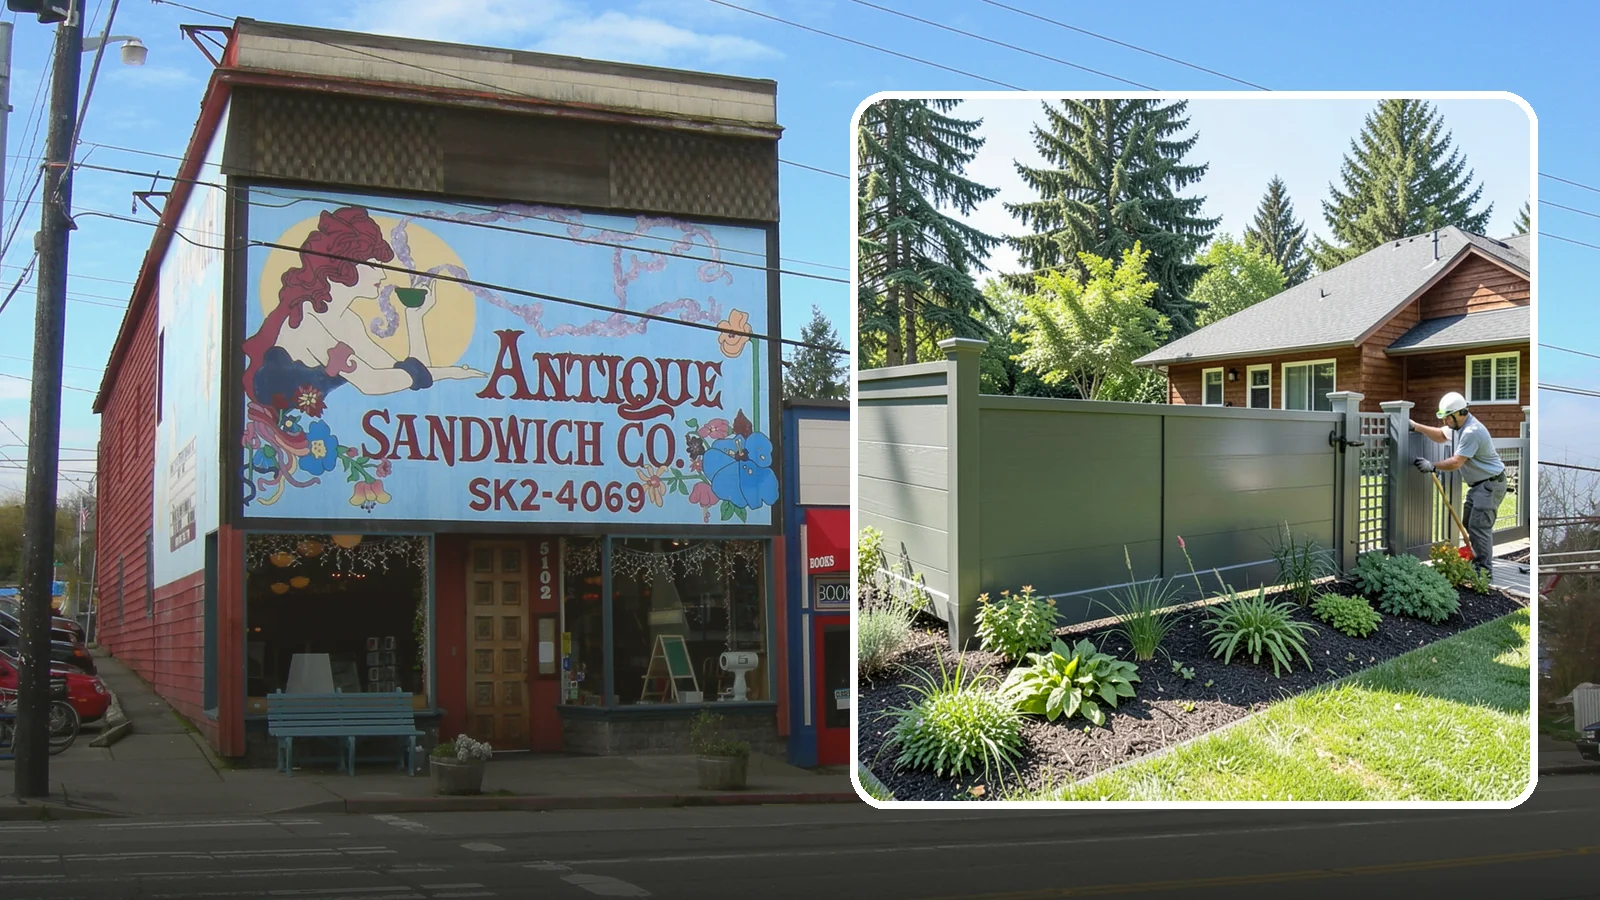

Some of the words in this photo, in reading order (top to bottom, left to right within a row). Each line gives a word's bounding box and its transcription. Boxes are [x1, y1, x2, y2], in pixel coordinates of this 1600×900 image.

[476, 330, 723, 420] ANTIQUE
[361, 408, 604, 467] SANDWICH
[617, 422, 685, 468] CO.
[468, 477, 646, 512] SK2-4069
[539, 542, 551, 600] 5102
[809, 555, 835, 569] BOOKS
